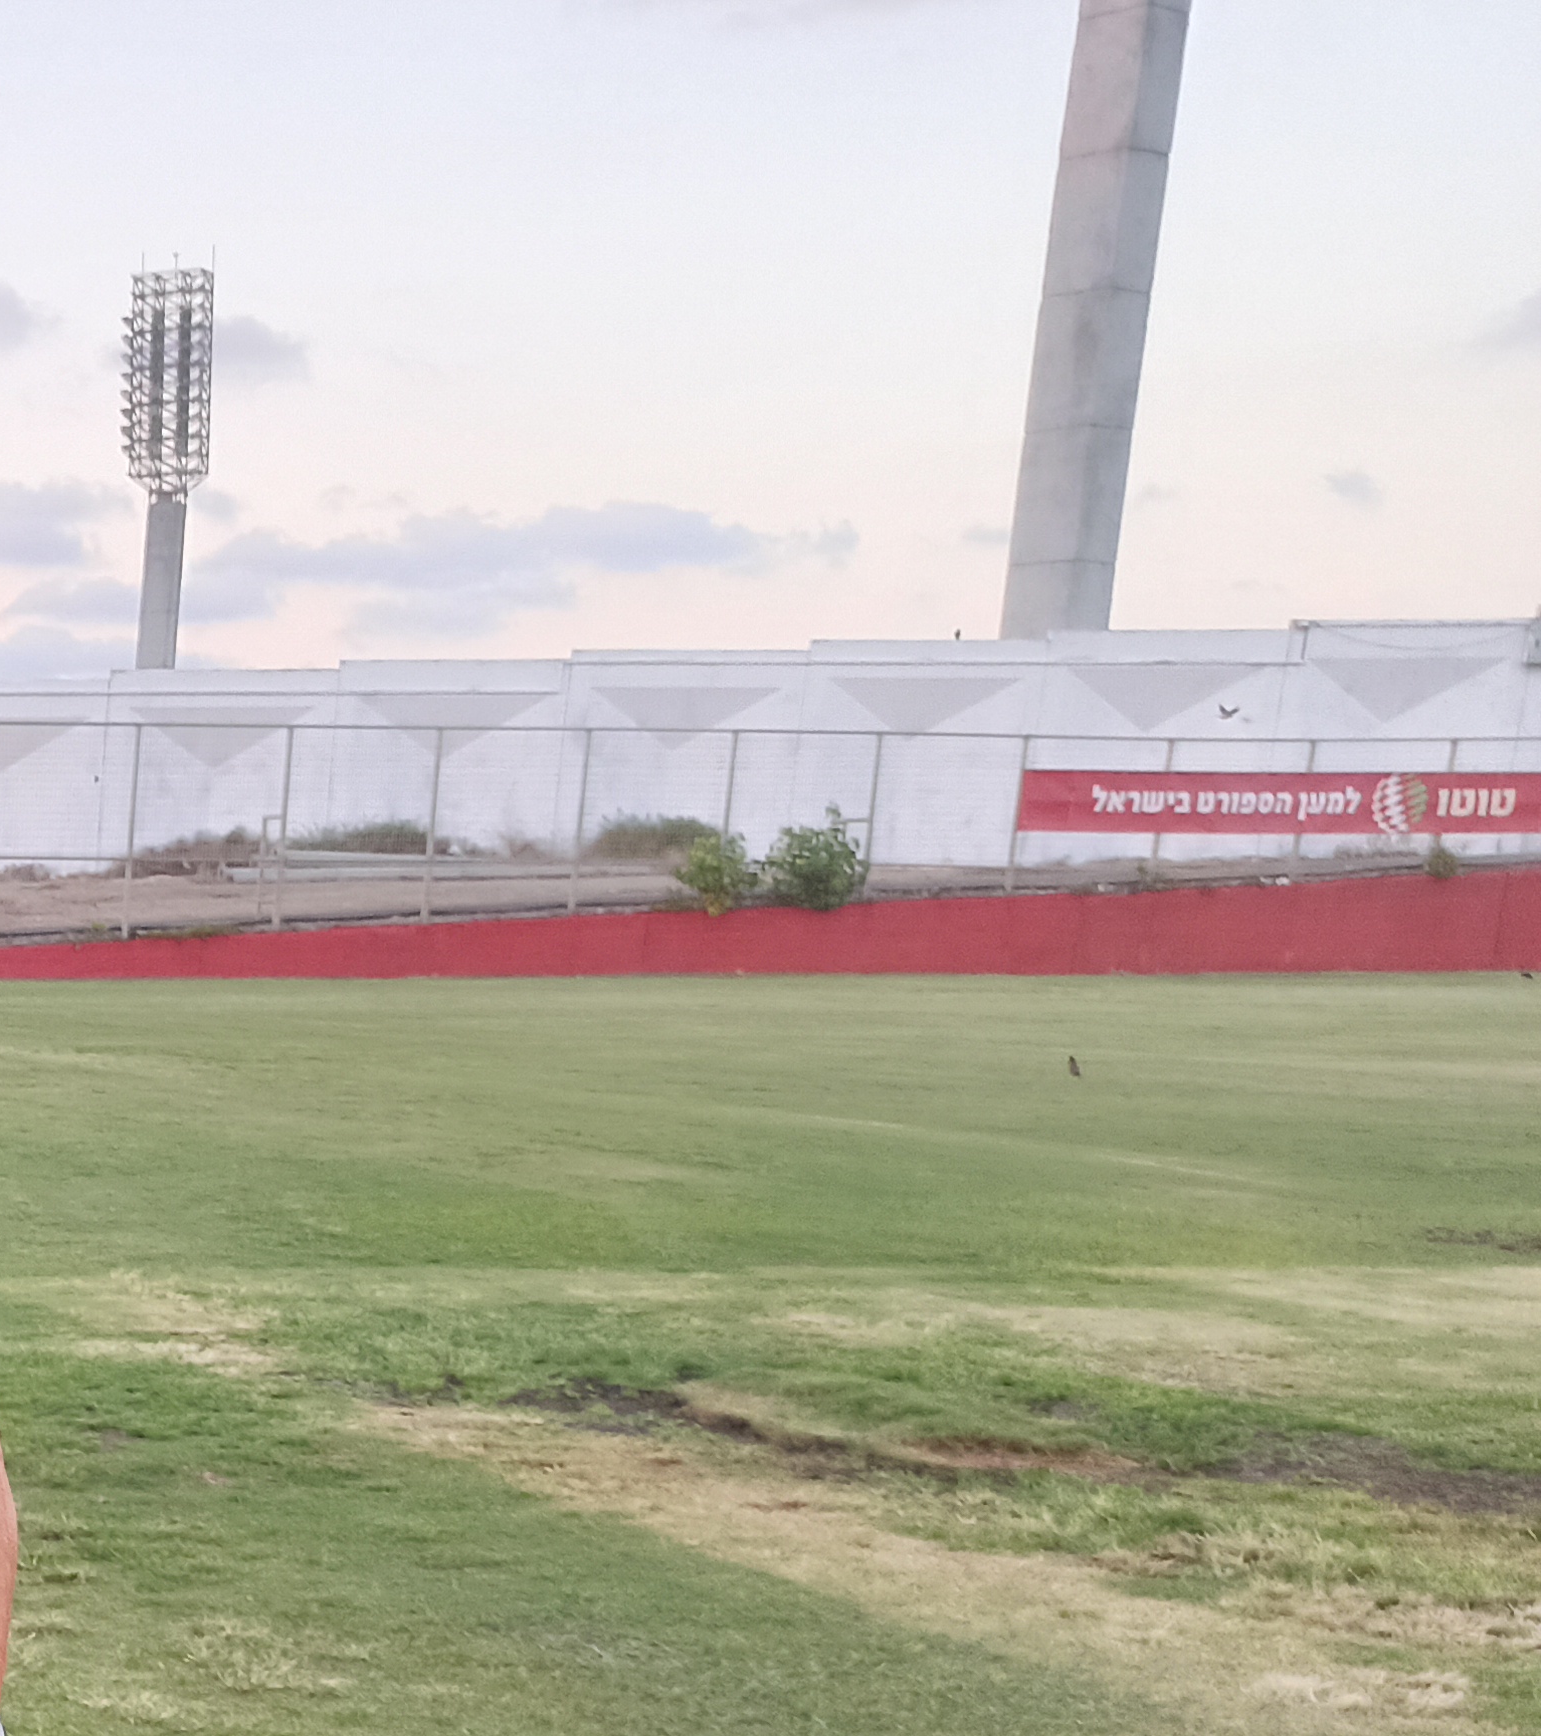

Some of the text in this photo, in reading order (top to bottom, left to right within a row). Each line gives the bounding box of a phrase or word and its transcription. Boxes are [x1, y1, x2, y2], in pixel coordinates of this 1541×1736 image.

[1091, 784, 1517, 822] טוטו למען הספורט בישראל
